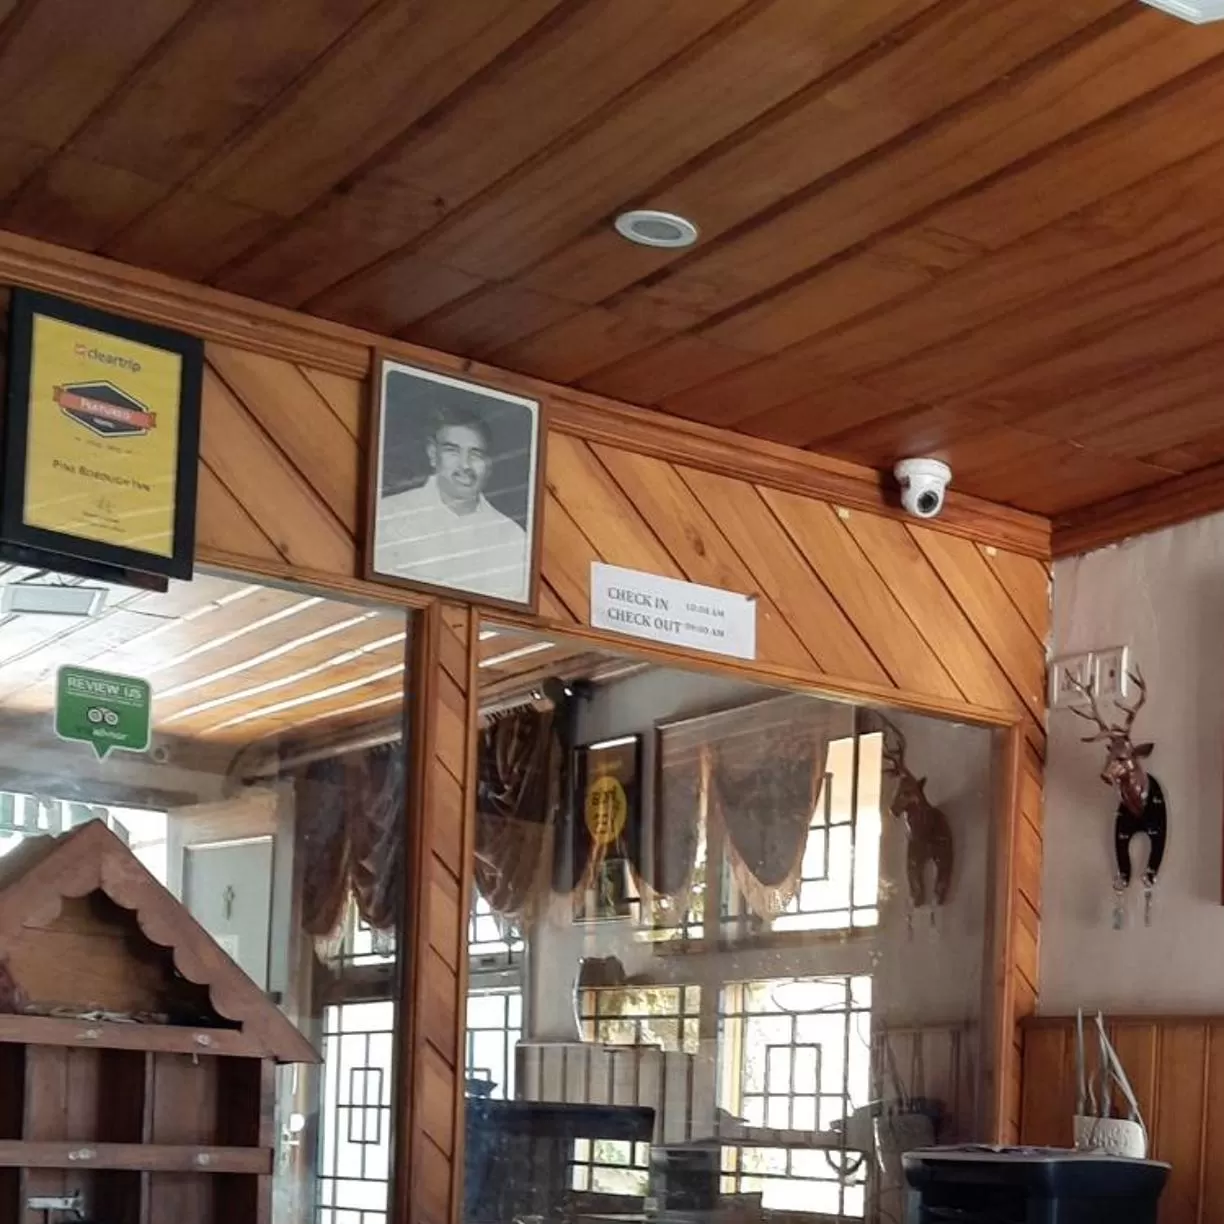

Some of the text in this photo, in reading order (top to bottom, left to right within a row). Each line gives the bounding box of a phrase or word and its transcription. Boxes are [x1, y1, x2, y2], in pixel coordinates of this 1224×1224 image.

[607, 586, 653, 608] CHECK
[655, 597, 669, 612] IN
[607, 607, 652, 628] CHECK
[653, 617, 682, 634] OUT
[67, 676, 119, 694] REVIEW
